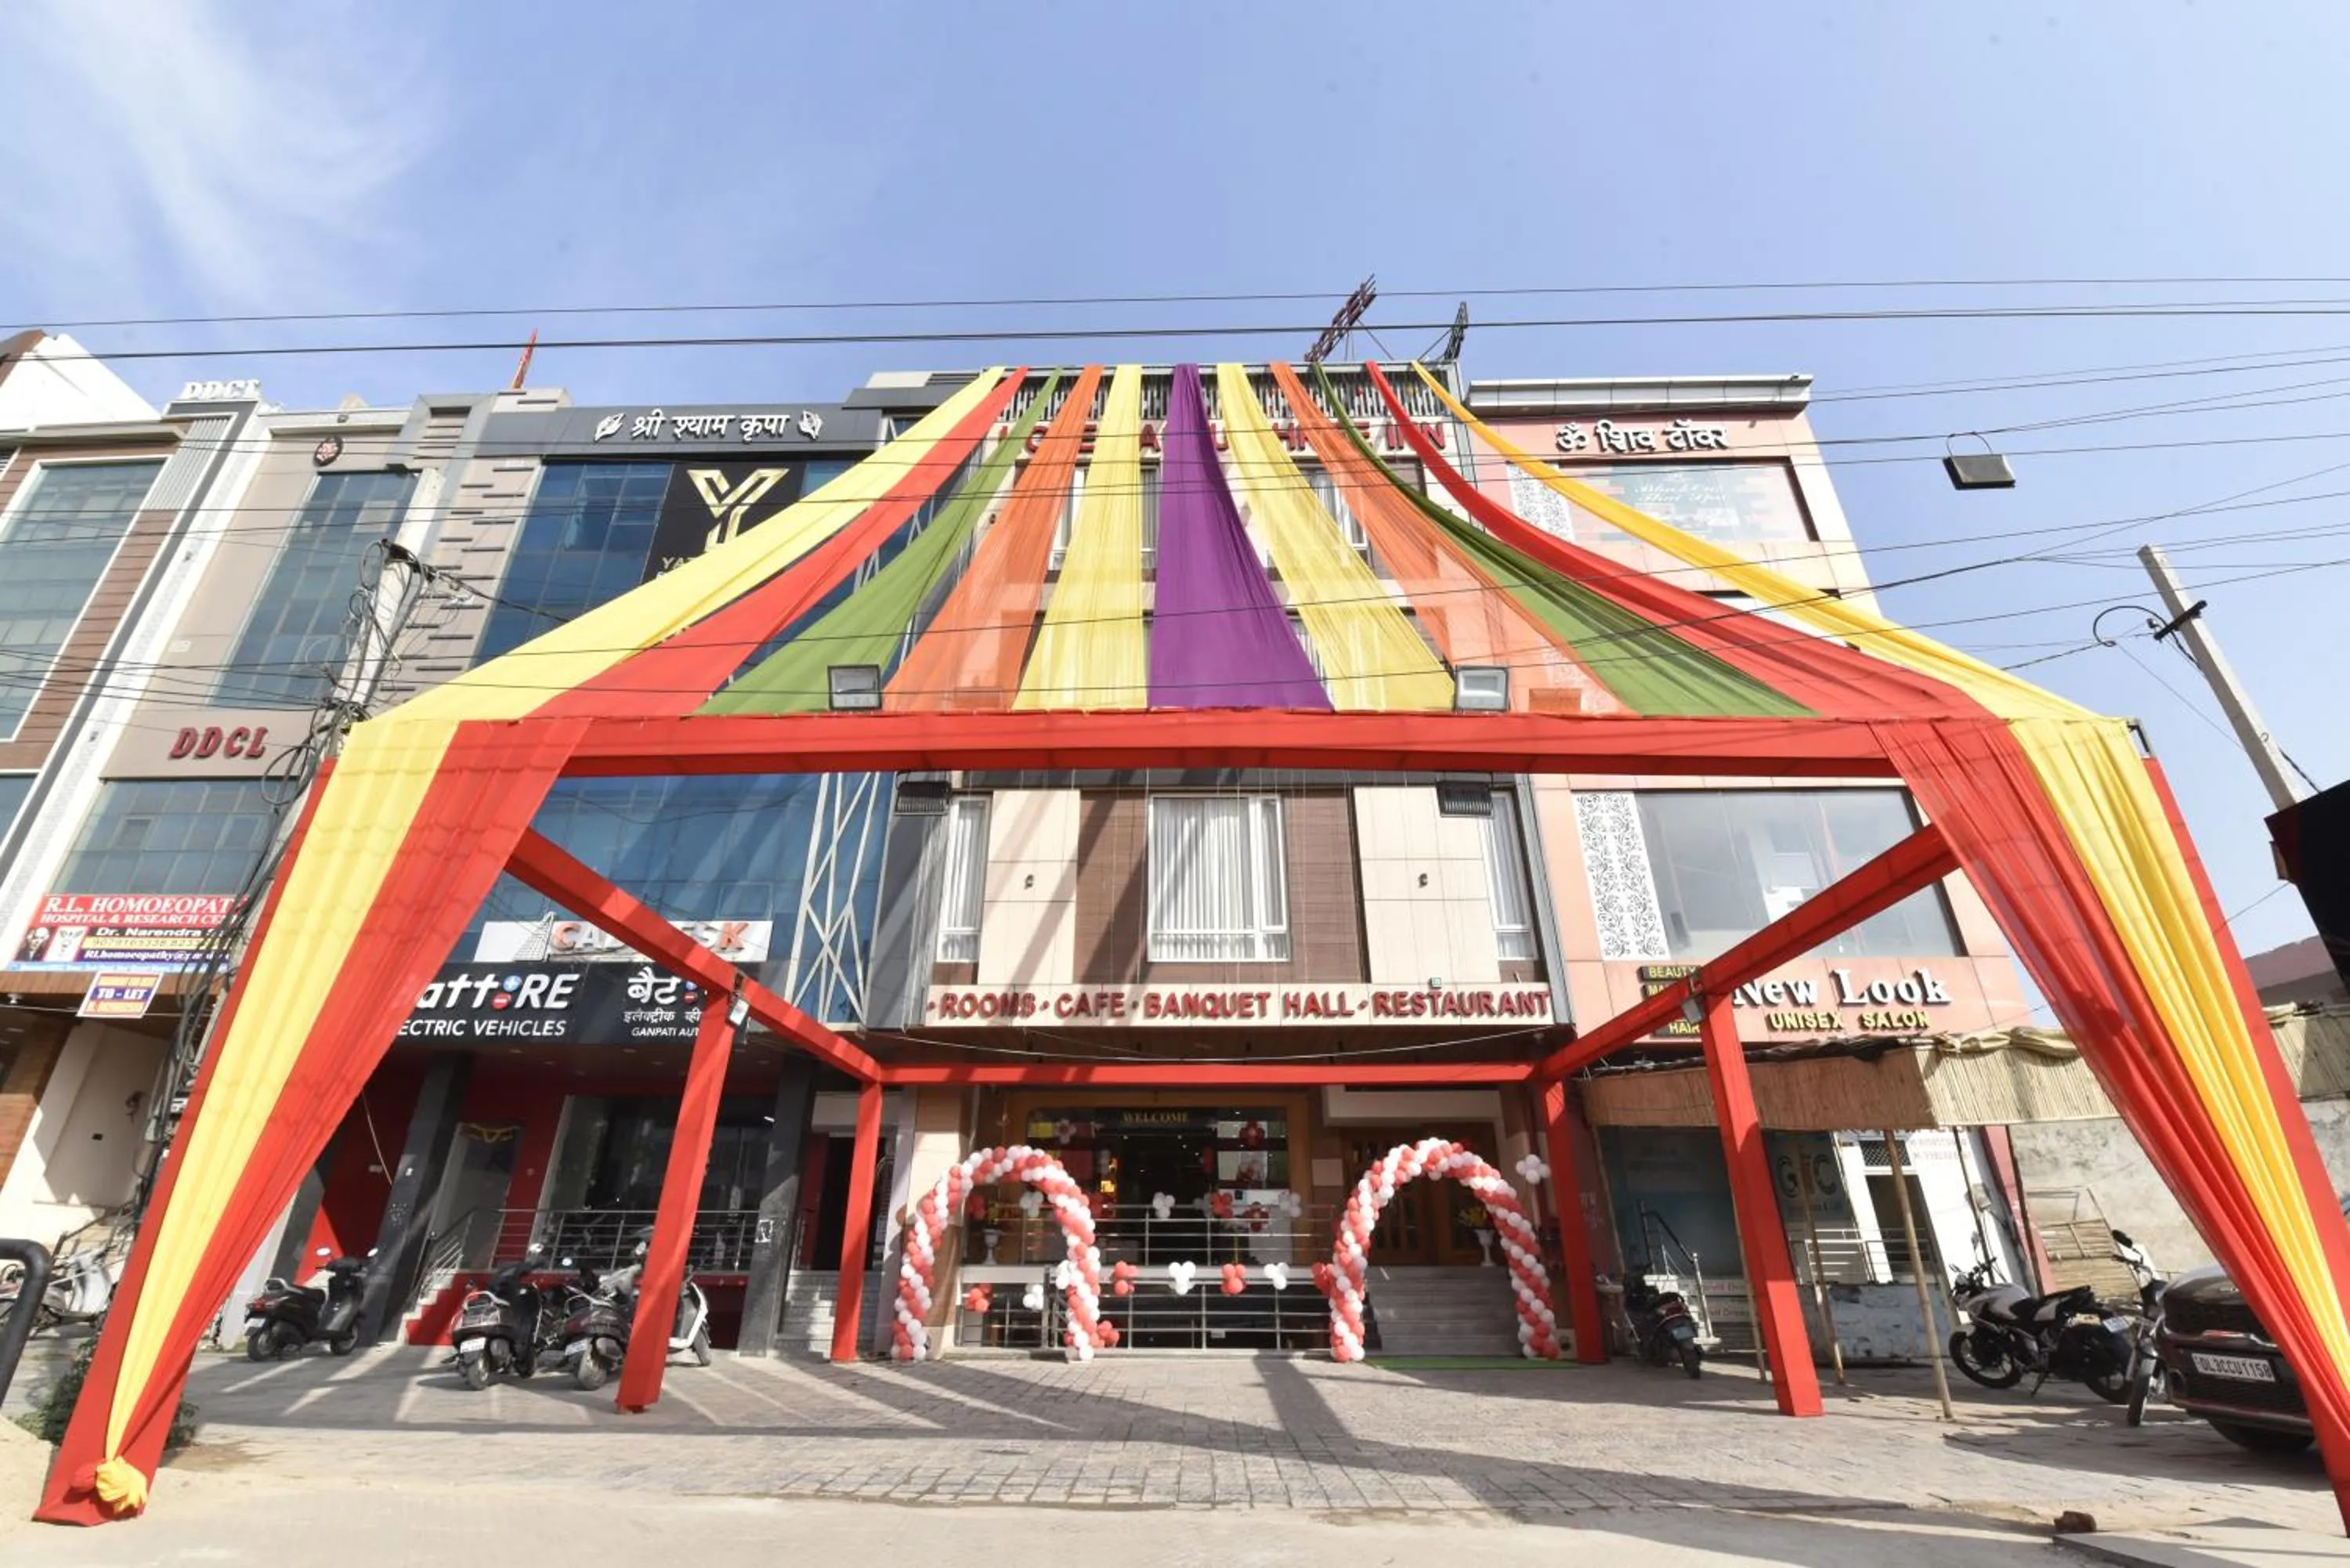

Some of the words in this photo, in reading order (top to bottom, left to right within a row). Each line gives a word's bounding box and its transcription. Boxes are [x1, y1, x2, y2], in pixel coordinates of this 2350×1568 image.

[632, 408, 667, 439] श्री
[671, 414, 736, 439] श्याम
[739, 414, 790, 443] कृपा
[1594, 419, 1657, 453] शिव
[168, 726, 268, 759] DDCL
[45, 897, 84, 912] R.L.
[90, 897, 248, 914] HOMOEOPAT
[40, 913, 107, 924] HOSPITAL
[123, 913, 200, 924] RESEARCH
[125, 928, 202, 937] Narendra
[1732, 978, 1820, 1006] New
[1832, 967, 1952, 1006] Look
[940, 991, 1037, 1019] ROOMS
[1053, 991, 1126, 1019] CAFE
[1143, 991, 1271, 1019] BANQUET
[1282, 991, 1354, 1018] HALL
[1370, 990, 1550, 1018] RESTAURANT
[397, 1019, 467, 1035] ECTRIC
[473, 1019, 567, 1036] VEHICLES
[1768, 1011, 1843, 1031] UNISEX
[1861, 1010, 1932, 1030] SALON
[631, 1027, 676, 1037] GANPATI
[678, 1027, 700, 1037] AUT
